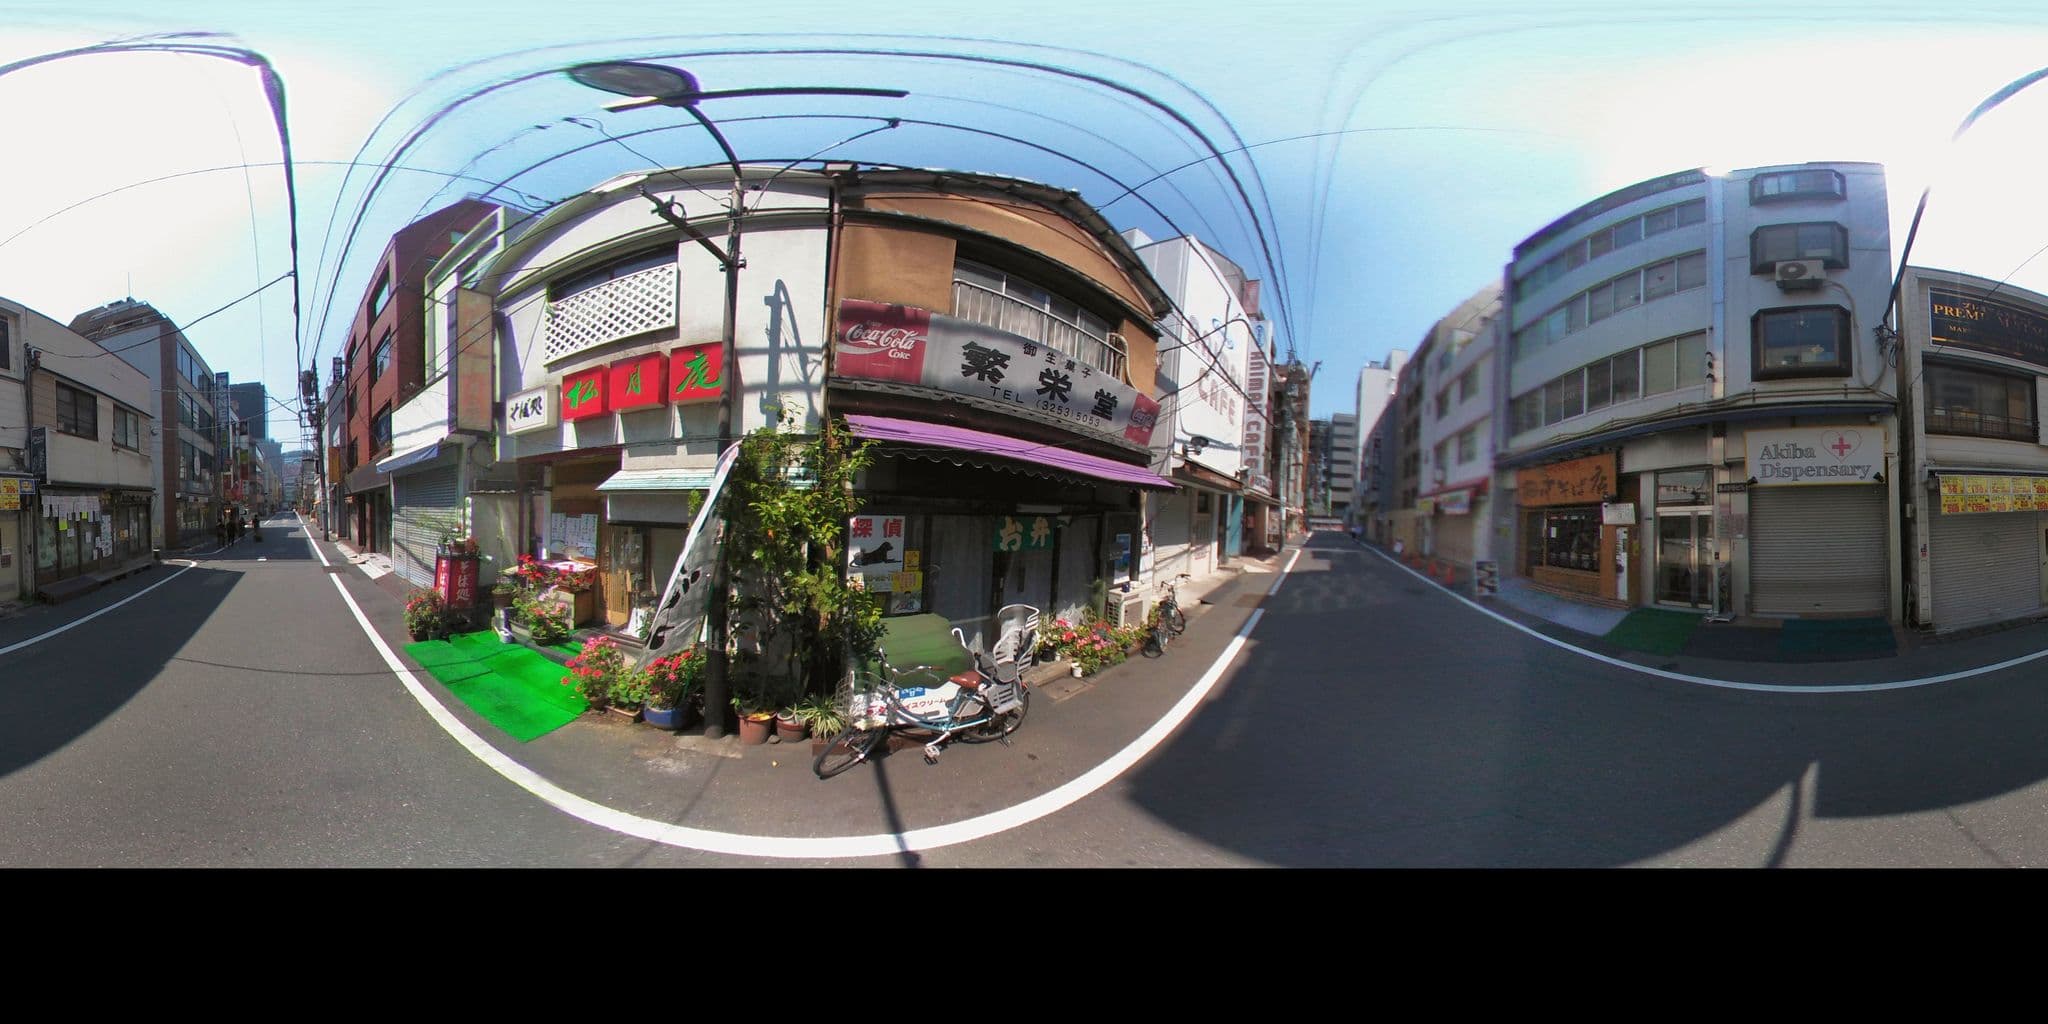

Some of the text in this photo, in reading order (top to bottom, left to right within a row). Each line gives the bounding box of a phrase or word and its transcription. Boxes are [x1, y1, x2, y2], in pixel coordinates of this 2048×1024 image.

[846, 323, 919, 350] Coca-Cola
[888, 348, 912, 360] Coke
[961, 341, 1119, 421] 繁栄堂
[510, 396, 543, 422] そば処
[990, 385, 1101, 427] TEL (3253)5053
[1198, 367, 1237, 426] CAFE
[1760, 443, 1816, 461] Akiba
[1760, 462, 1872, 482] Dispensary
[852, 518, 903, 538] 探偵
[456, 560, 471, 601] そば処
